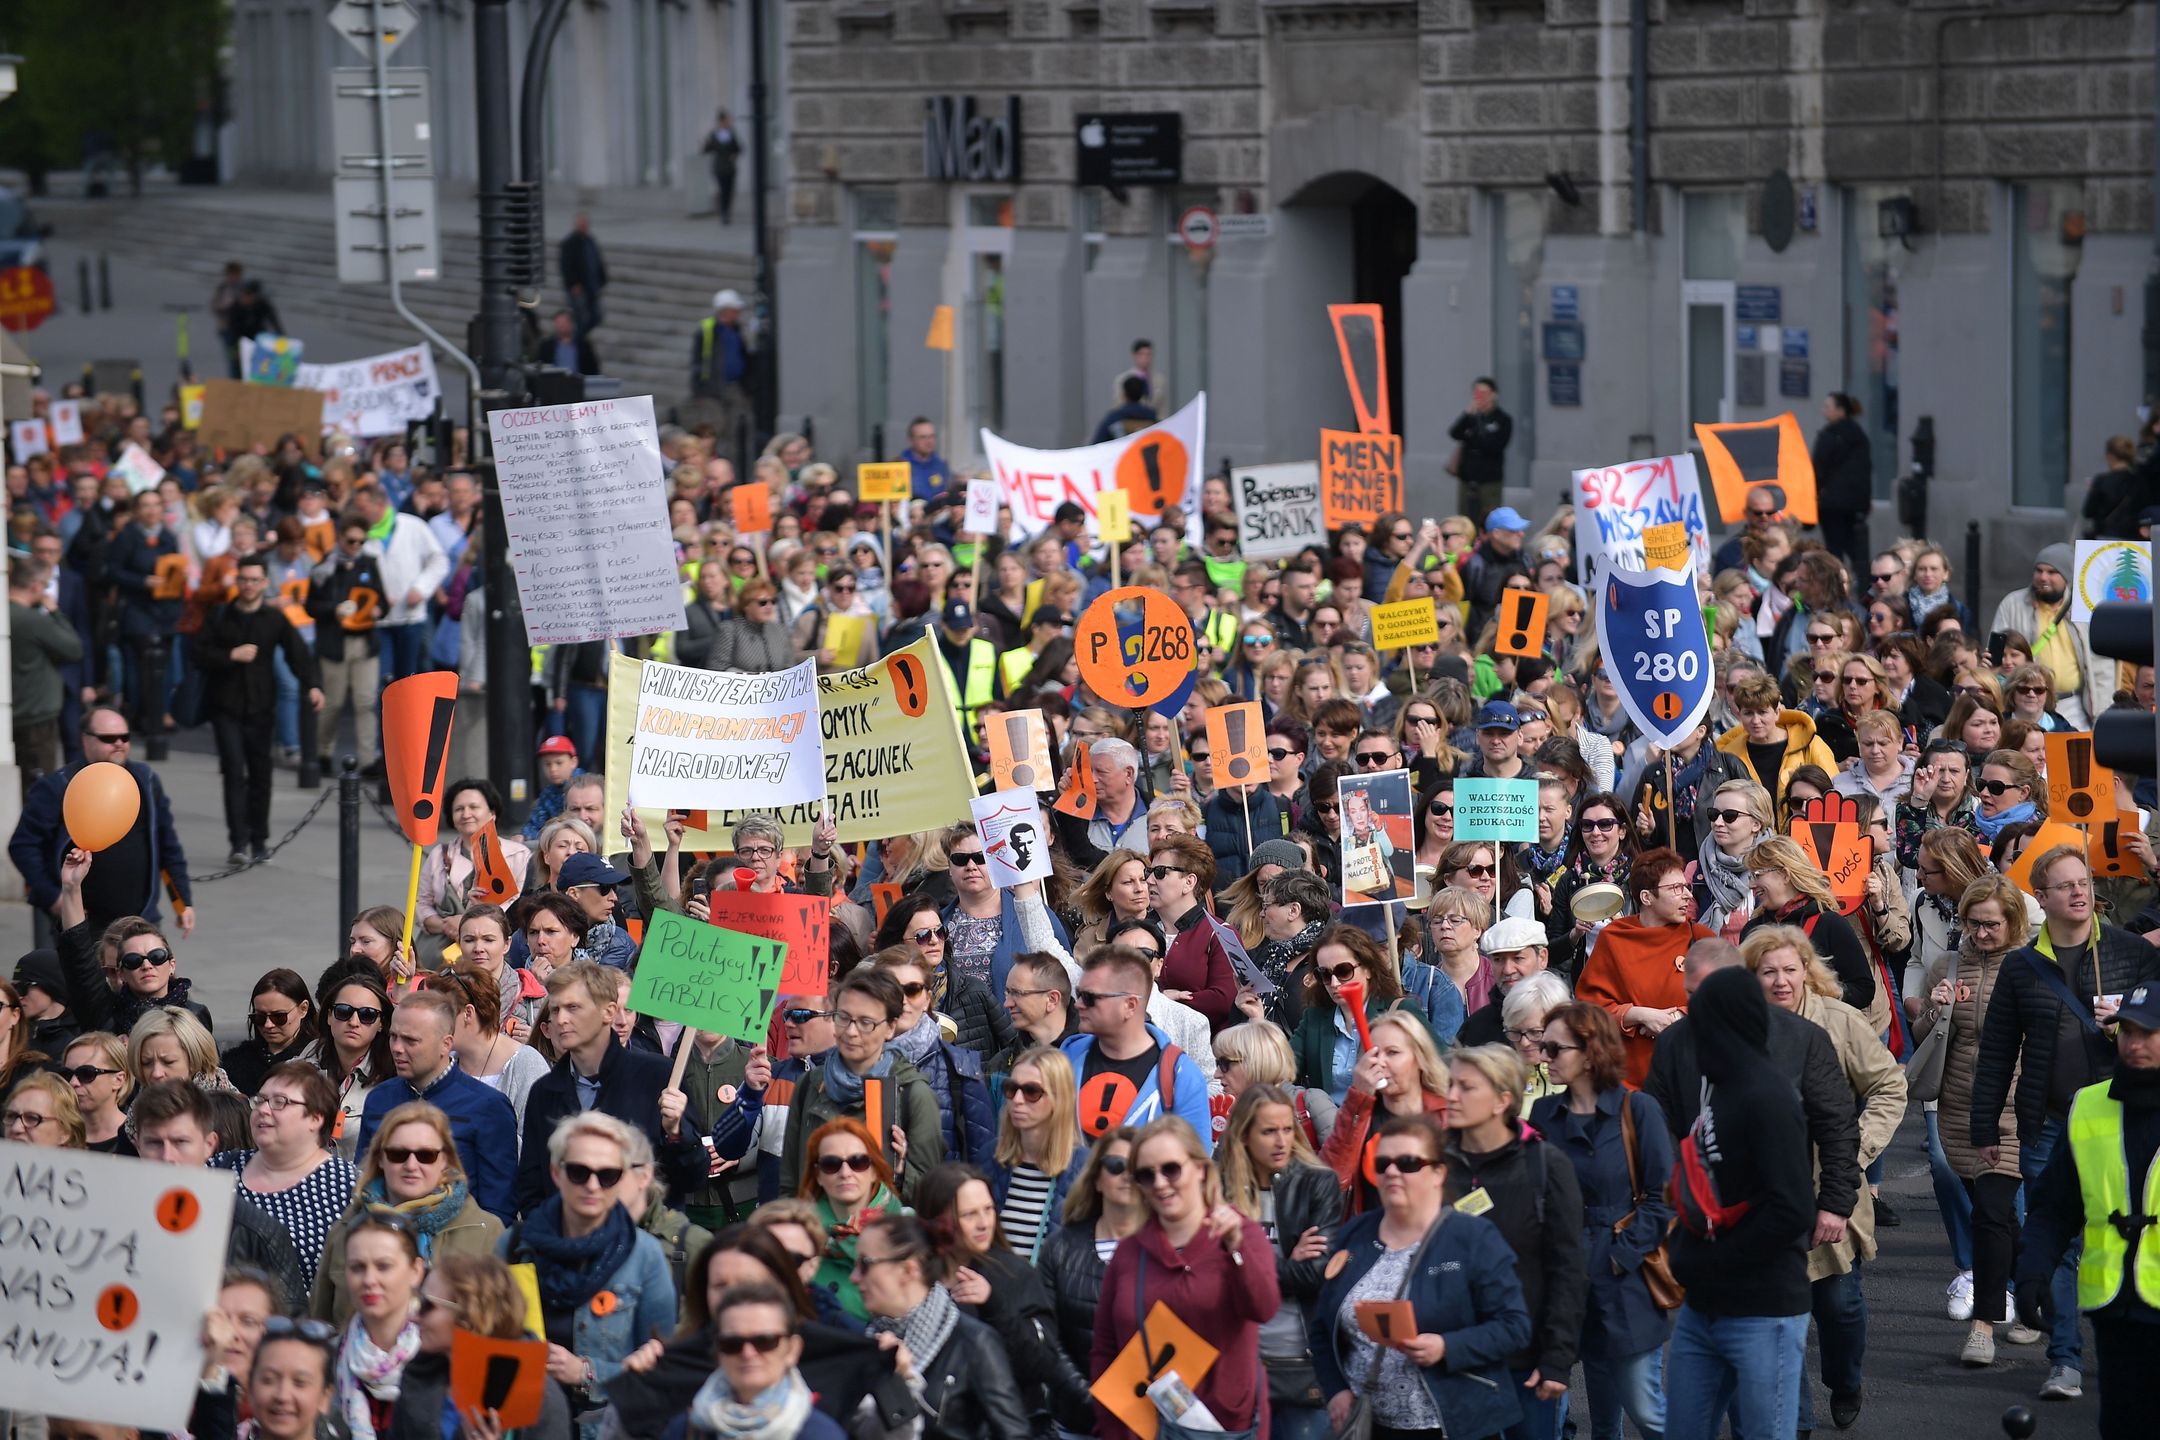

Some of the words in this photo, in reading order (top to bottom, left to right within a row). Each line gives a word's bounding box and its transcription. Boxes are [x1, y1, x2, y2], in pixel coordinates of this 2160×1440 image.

[1329, 440, 1395, 472] MEN
[1378, 606, 1428, 620] WALCZYMY
[1644, 607, 1682, 639] SP
[1090, 631, 1108, 664] P
[1146, 625, 1190, 662] 268
[1633, 649, 1699, 683] 280
[642, 661, 814, 706] MINISTERSTWO
[639, 704, 808, 744] KOMPROMITACJI
[637, 746, 791, 784] NARODOWEJ
[1468, 793, 1526, 803] WALCZYMY
[2050, 783, 2069, 802] SP
[2093, 783, 2108, 798] 10
[1458, 806, 1467, 814] O
[1470, 805, 1535, 815] PRZYSZŁOŚĆ
[1469, 818, 1525, 827] EDUKACJI!
[688, 970, 715, 987] do
[3, 1161, 90, 1210] NAS
